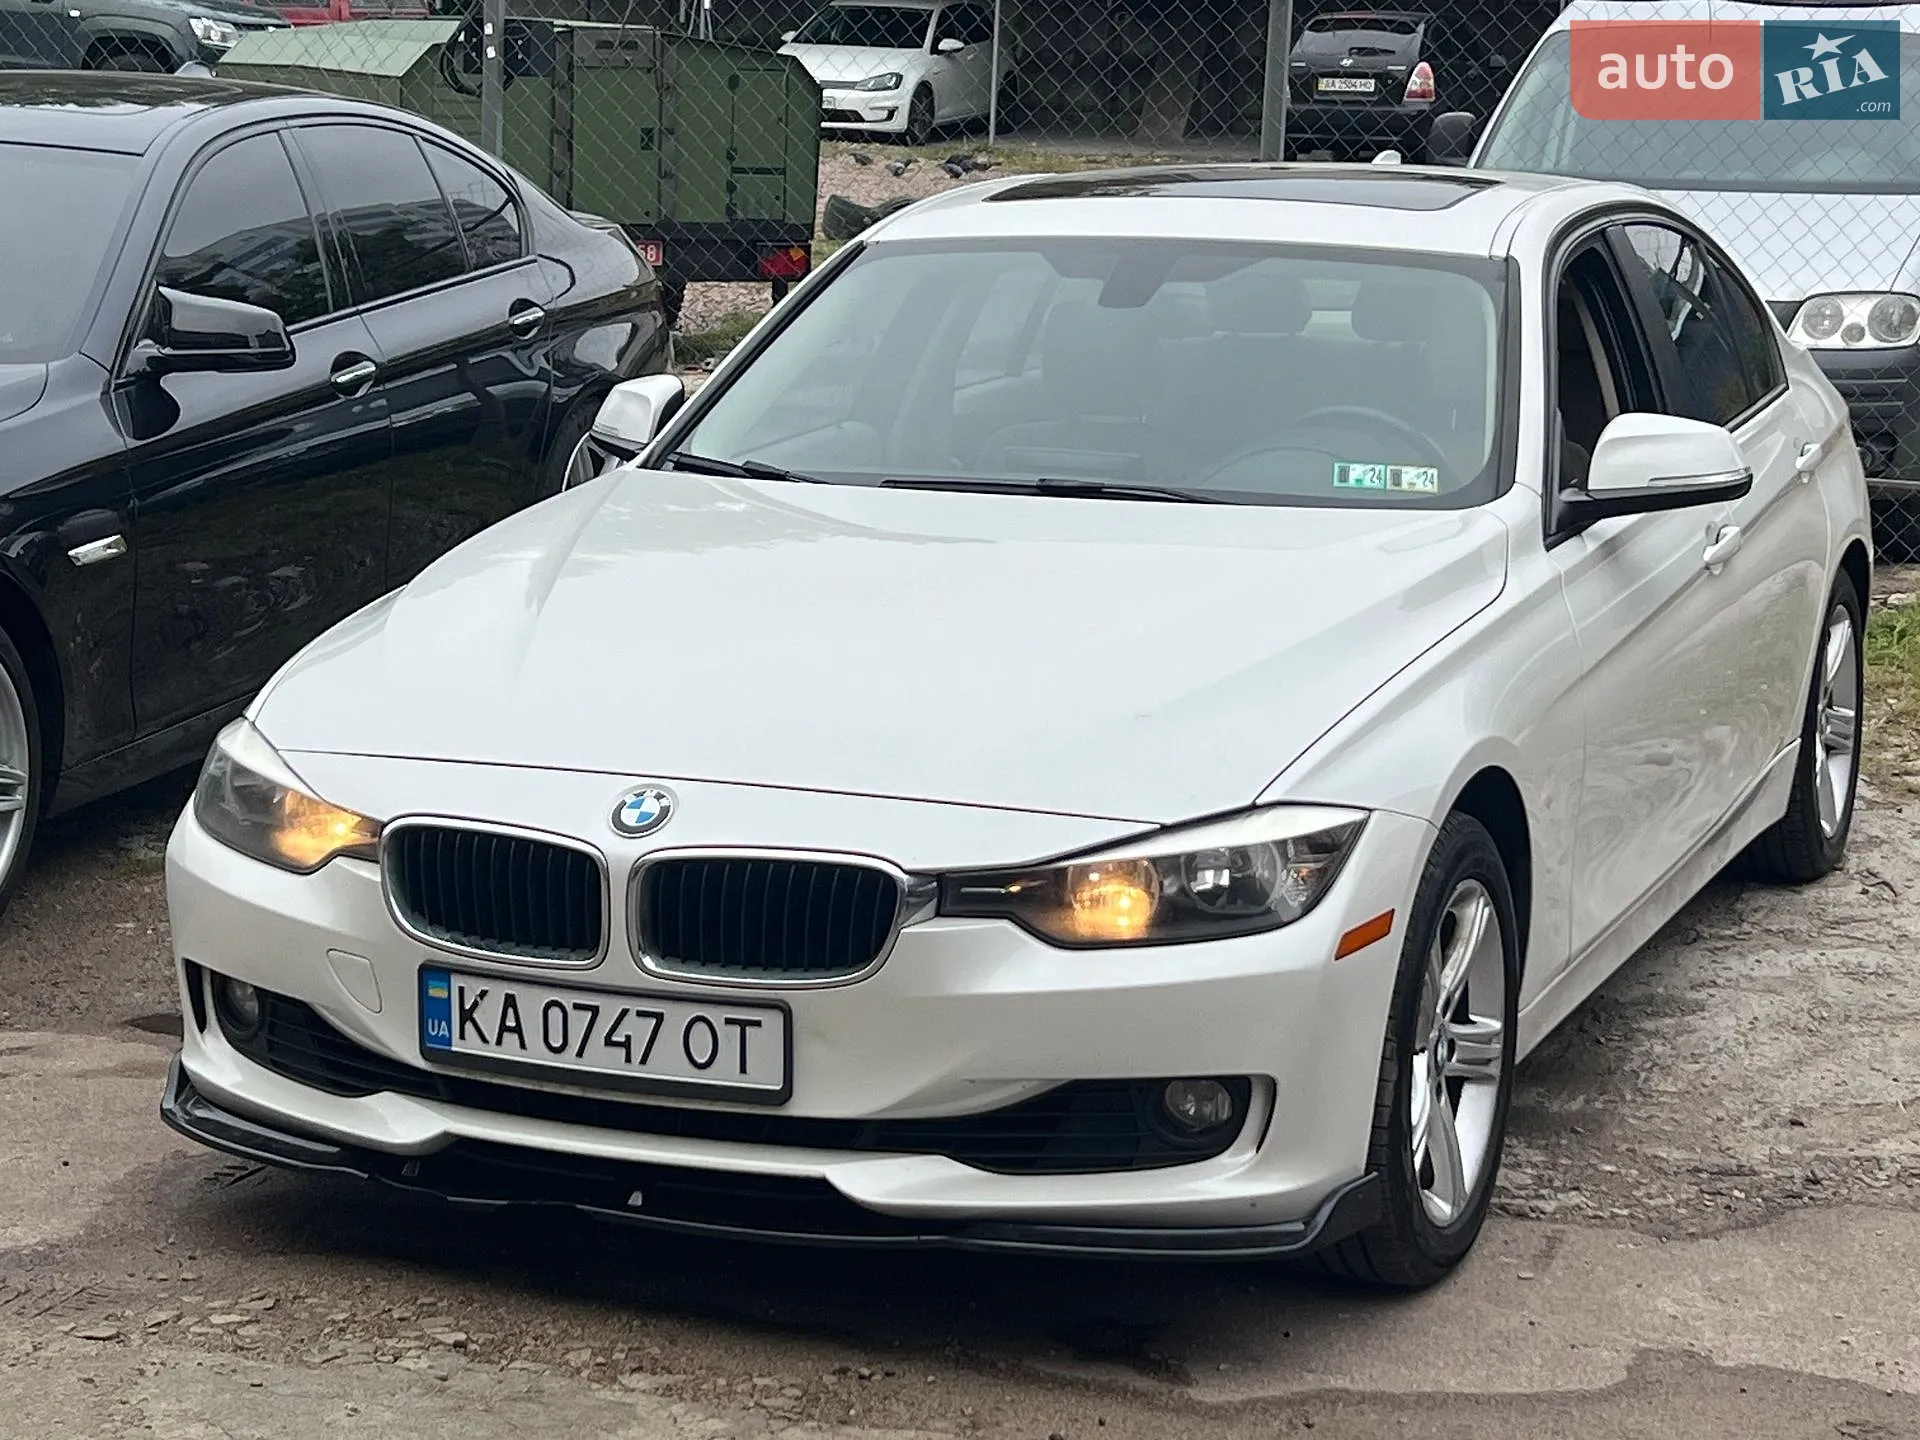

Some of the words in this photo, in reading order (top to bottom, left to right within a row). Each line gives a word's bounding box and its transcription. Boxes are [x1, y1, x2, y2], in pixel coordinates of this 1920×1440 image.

[428, 1018, 450, 1038] UA
[457, 985, 528, 1051] KA
[542, 998, 665, 1066] 0747
[682, 1014, 763, 1076] OT
